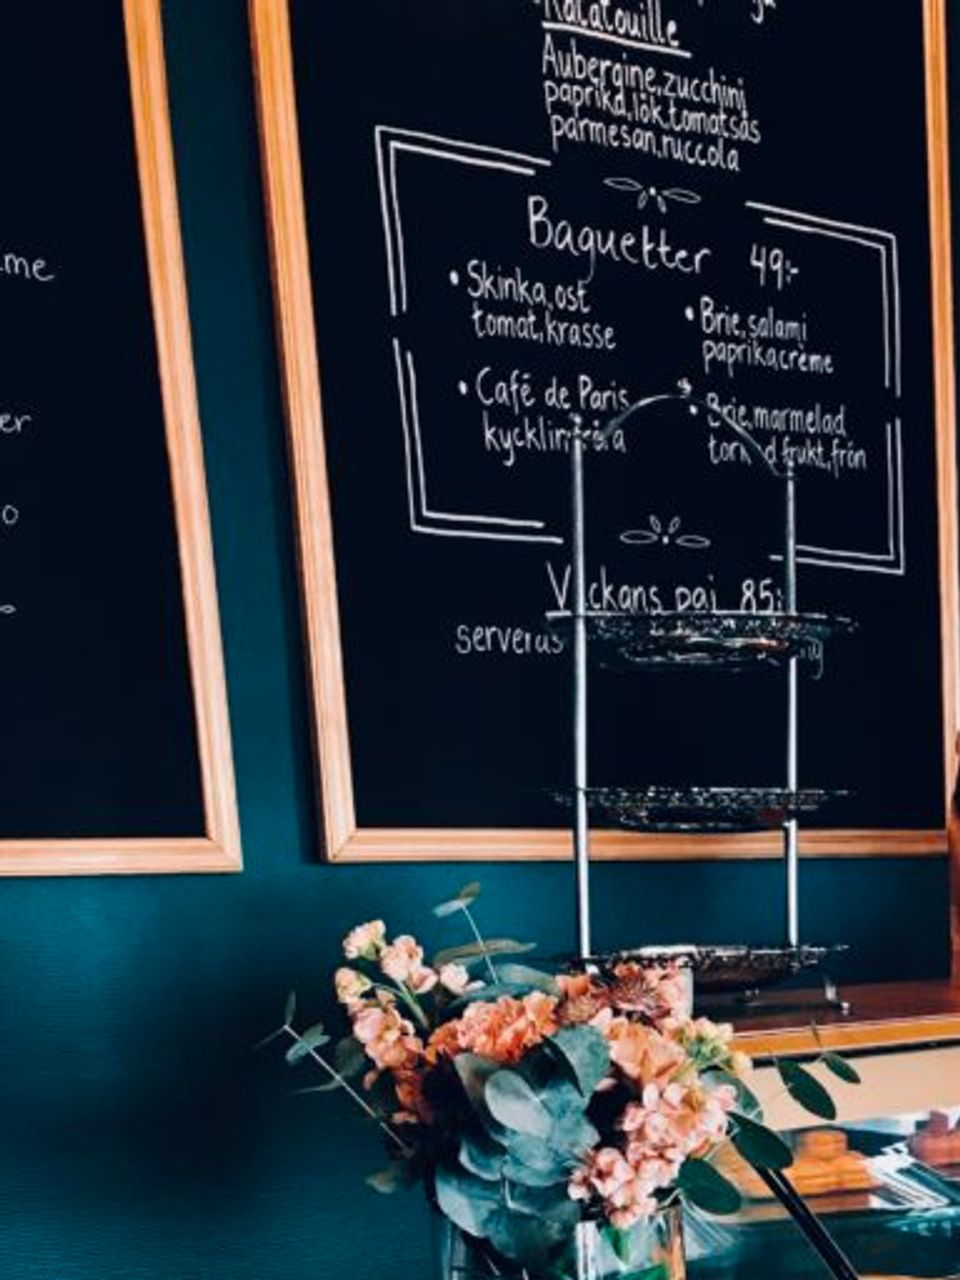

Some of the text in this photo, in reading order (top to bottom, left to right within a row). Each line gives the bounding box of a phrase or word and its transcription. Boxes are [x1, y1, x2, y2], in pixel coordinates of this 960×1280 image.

[528, 194, 799, 291] Baguetter 49:-
[476, 366, 629, 415] Café de Paris
[546, 561, 663, 613] Vckans
